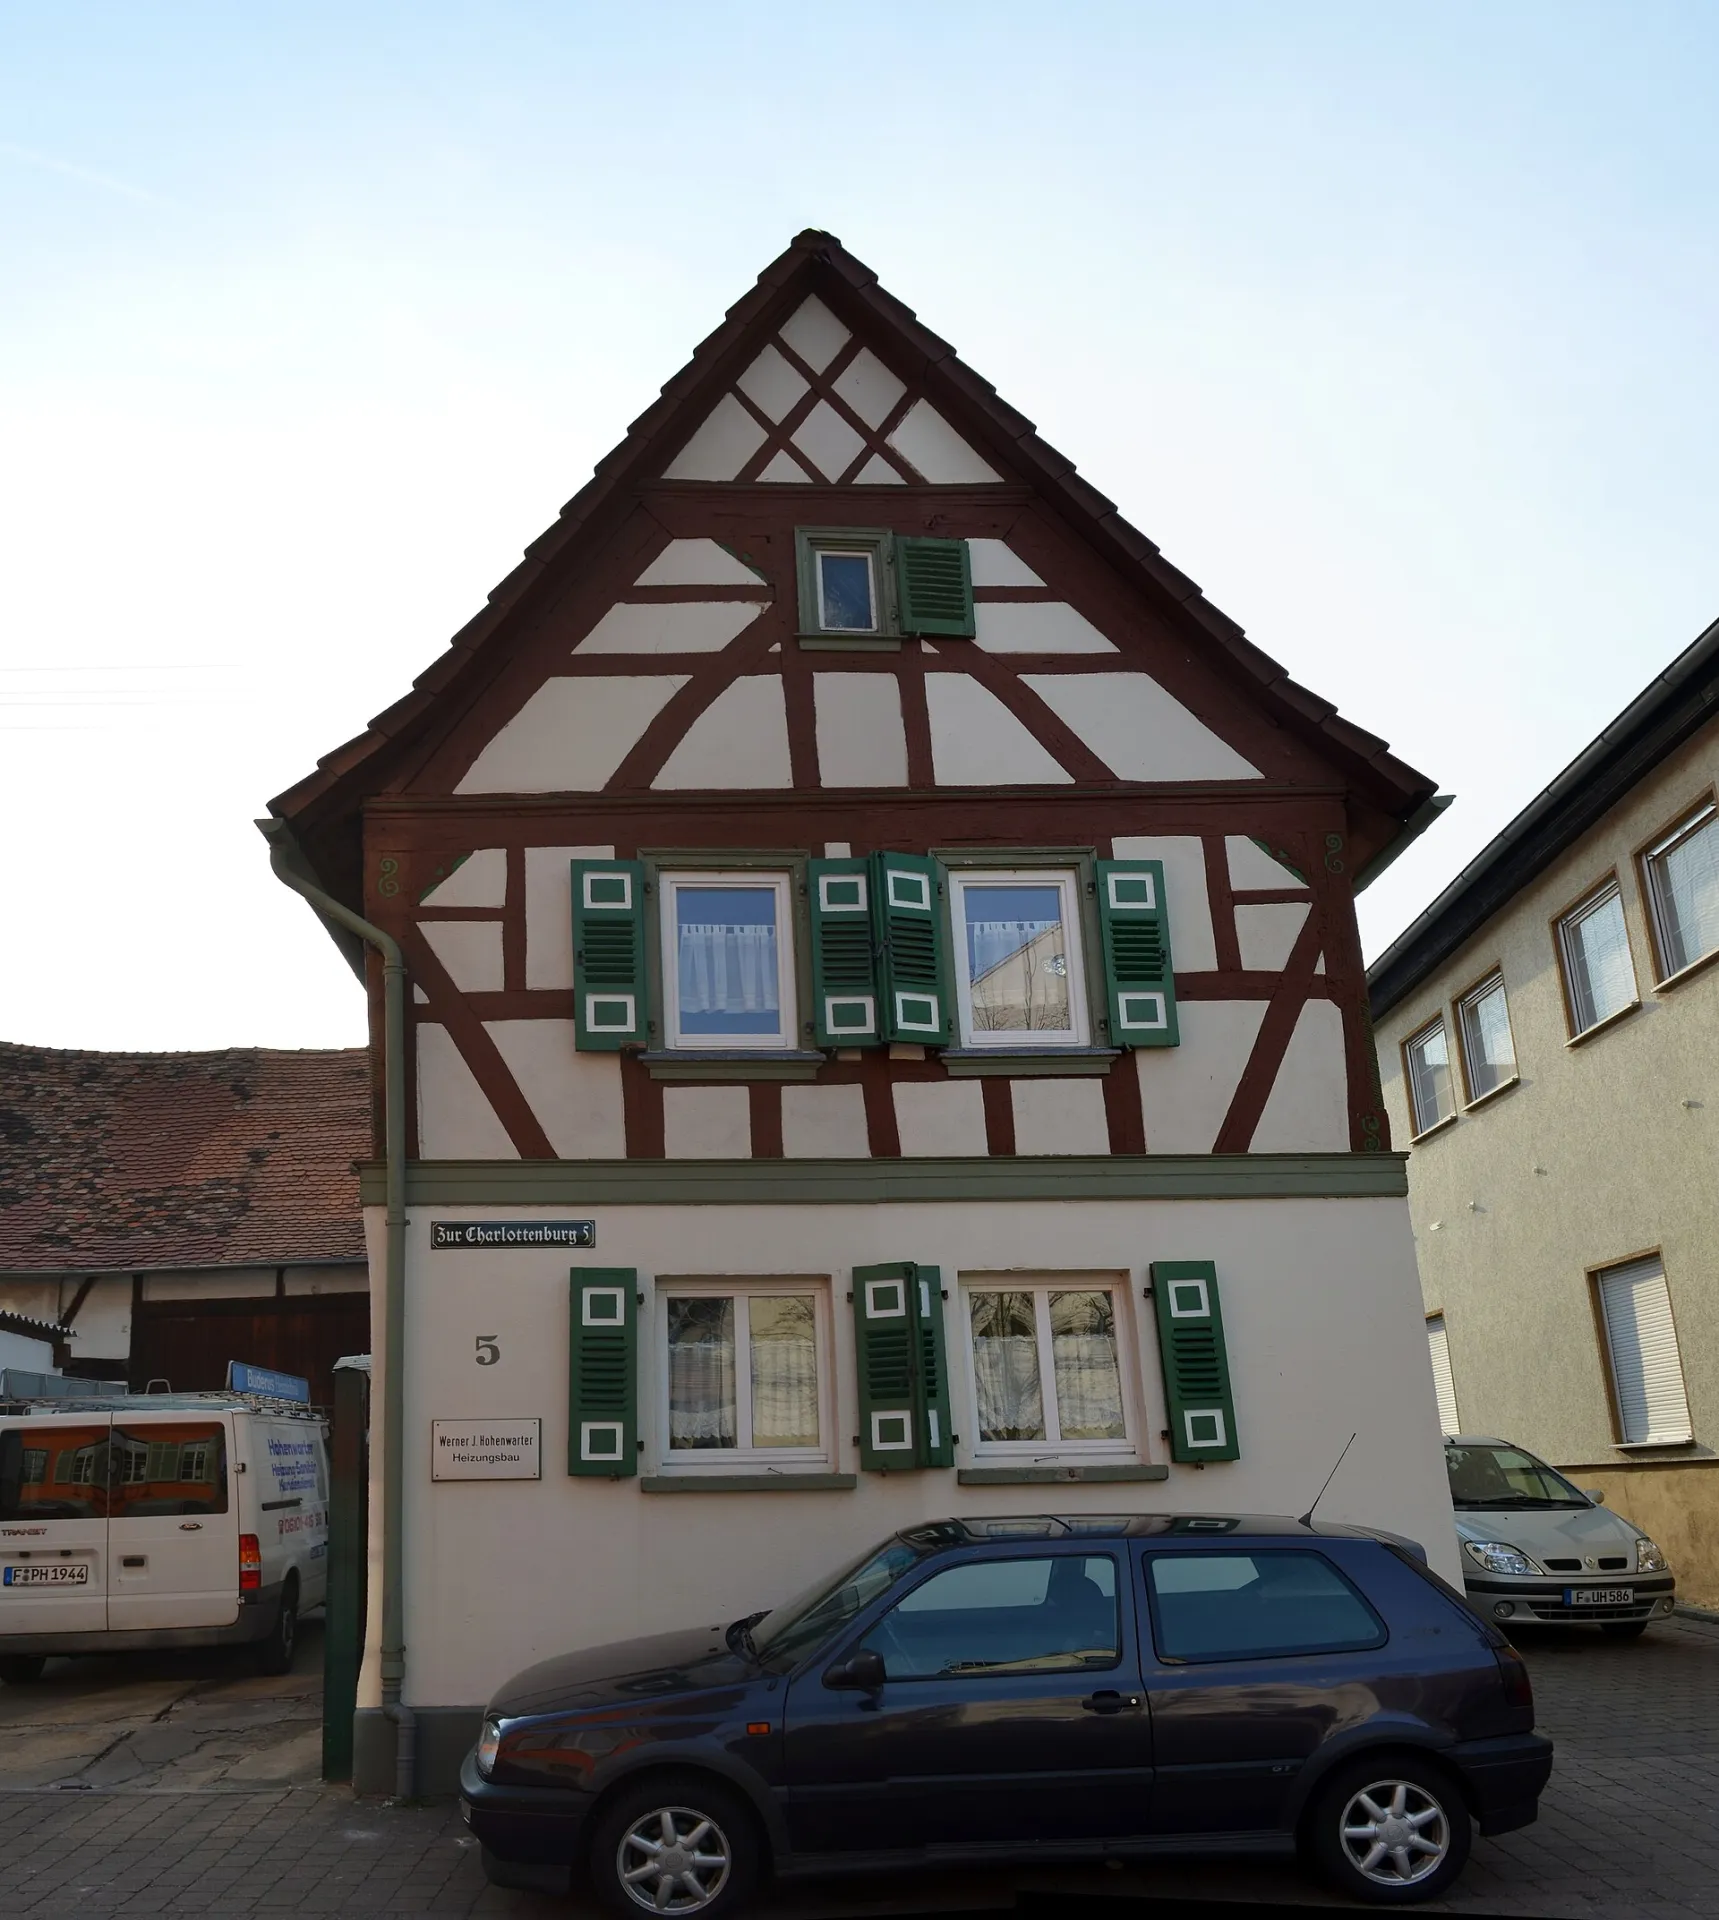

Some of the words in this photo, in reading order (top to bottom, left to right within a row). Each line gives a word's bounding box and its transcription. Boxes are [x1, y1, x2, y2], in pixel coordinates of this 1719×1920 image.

[437, 1226, 462, 1243] Zur
[465, 1225, 577, 1245] Charlottenburg
[582, 1225, 590, 1242] 5
[475, 1334, 501, 1366] 5
[439, 1435, 470, 1447] Werner
[479, 1435, 534, 1447] Hohenwarter
[452, 1453, 520, 1464] Heizungsbau
[51, 1567, 84, 1580] 1944
[1609, 1590, 1630, 1602] 586
